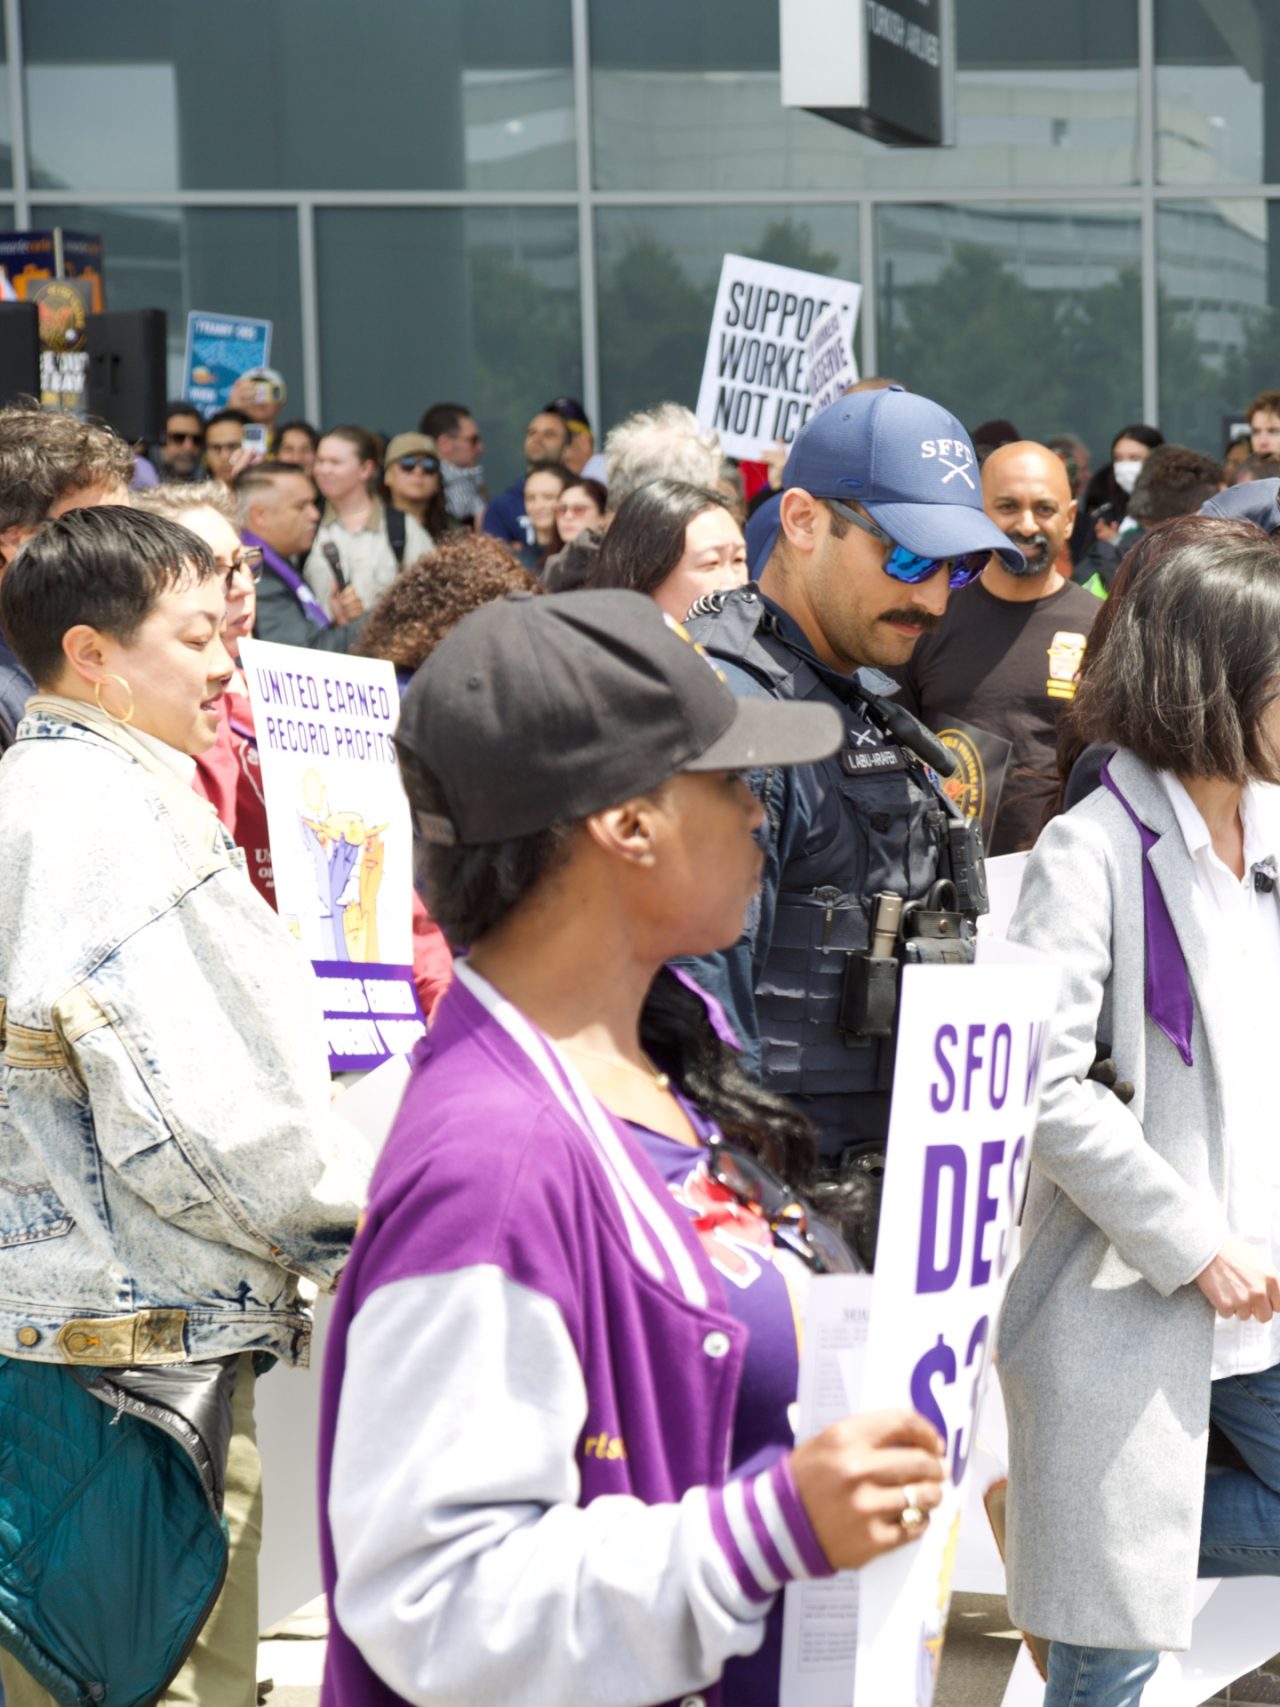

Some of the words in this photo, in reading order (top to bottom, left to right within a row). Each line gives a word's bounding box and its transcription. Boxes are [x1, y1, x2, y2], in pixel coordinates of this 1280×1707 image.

[726, 281, 830, 341] SUPPO
[718, 330, 811, 394] WORKE
[713, 384, 768, 437] NOT
[921, 439, 973, 464] SFPD
[256, 667, 320, 710] UNITED
[324, 678, 390, 720] EARNED
[267, 717, 330, 756] RECORD
[334, 726, 396, 764] PROFITS
[930, 1022, 1012, 1114] SFO
